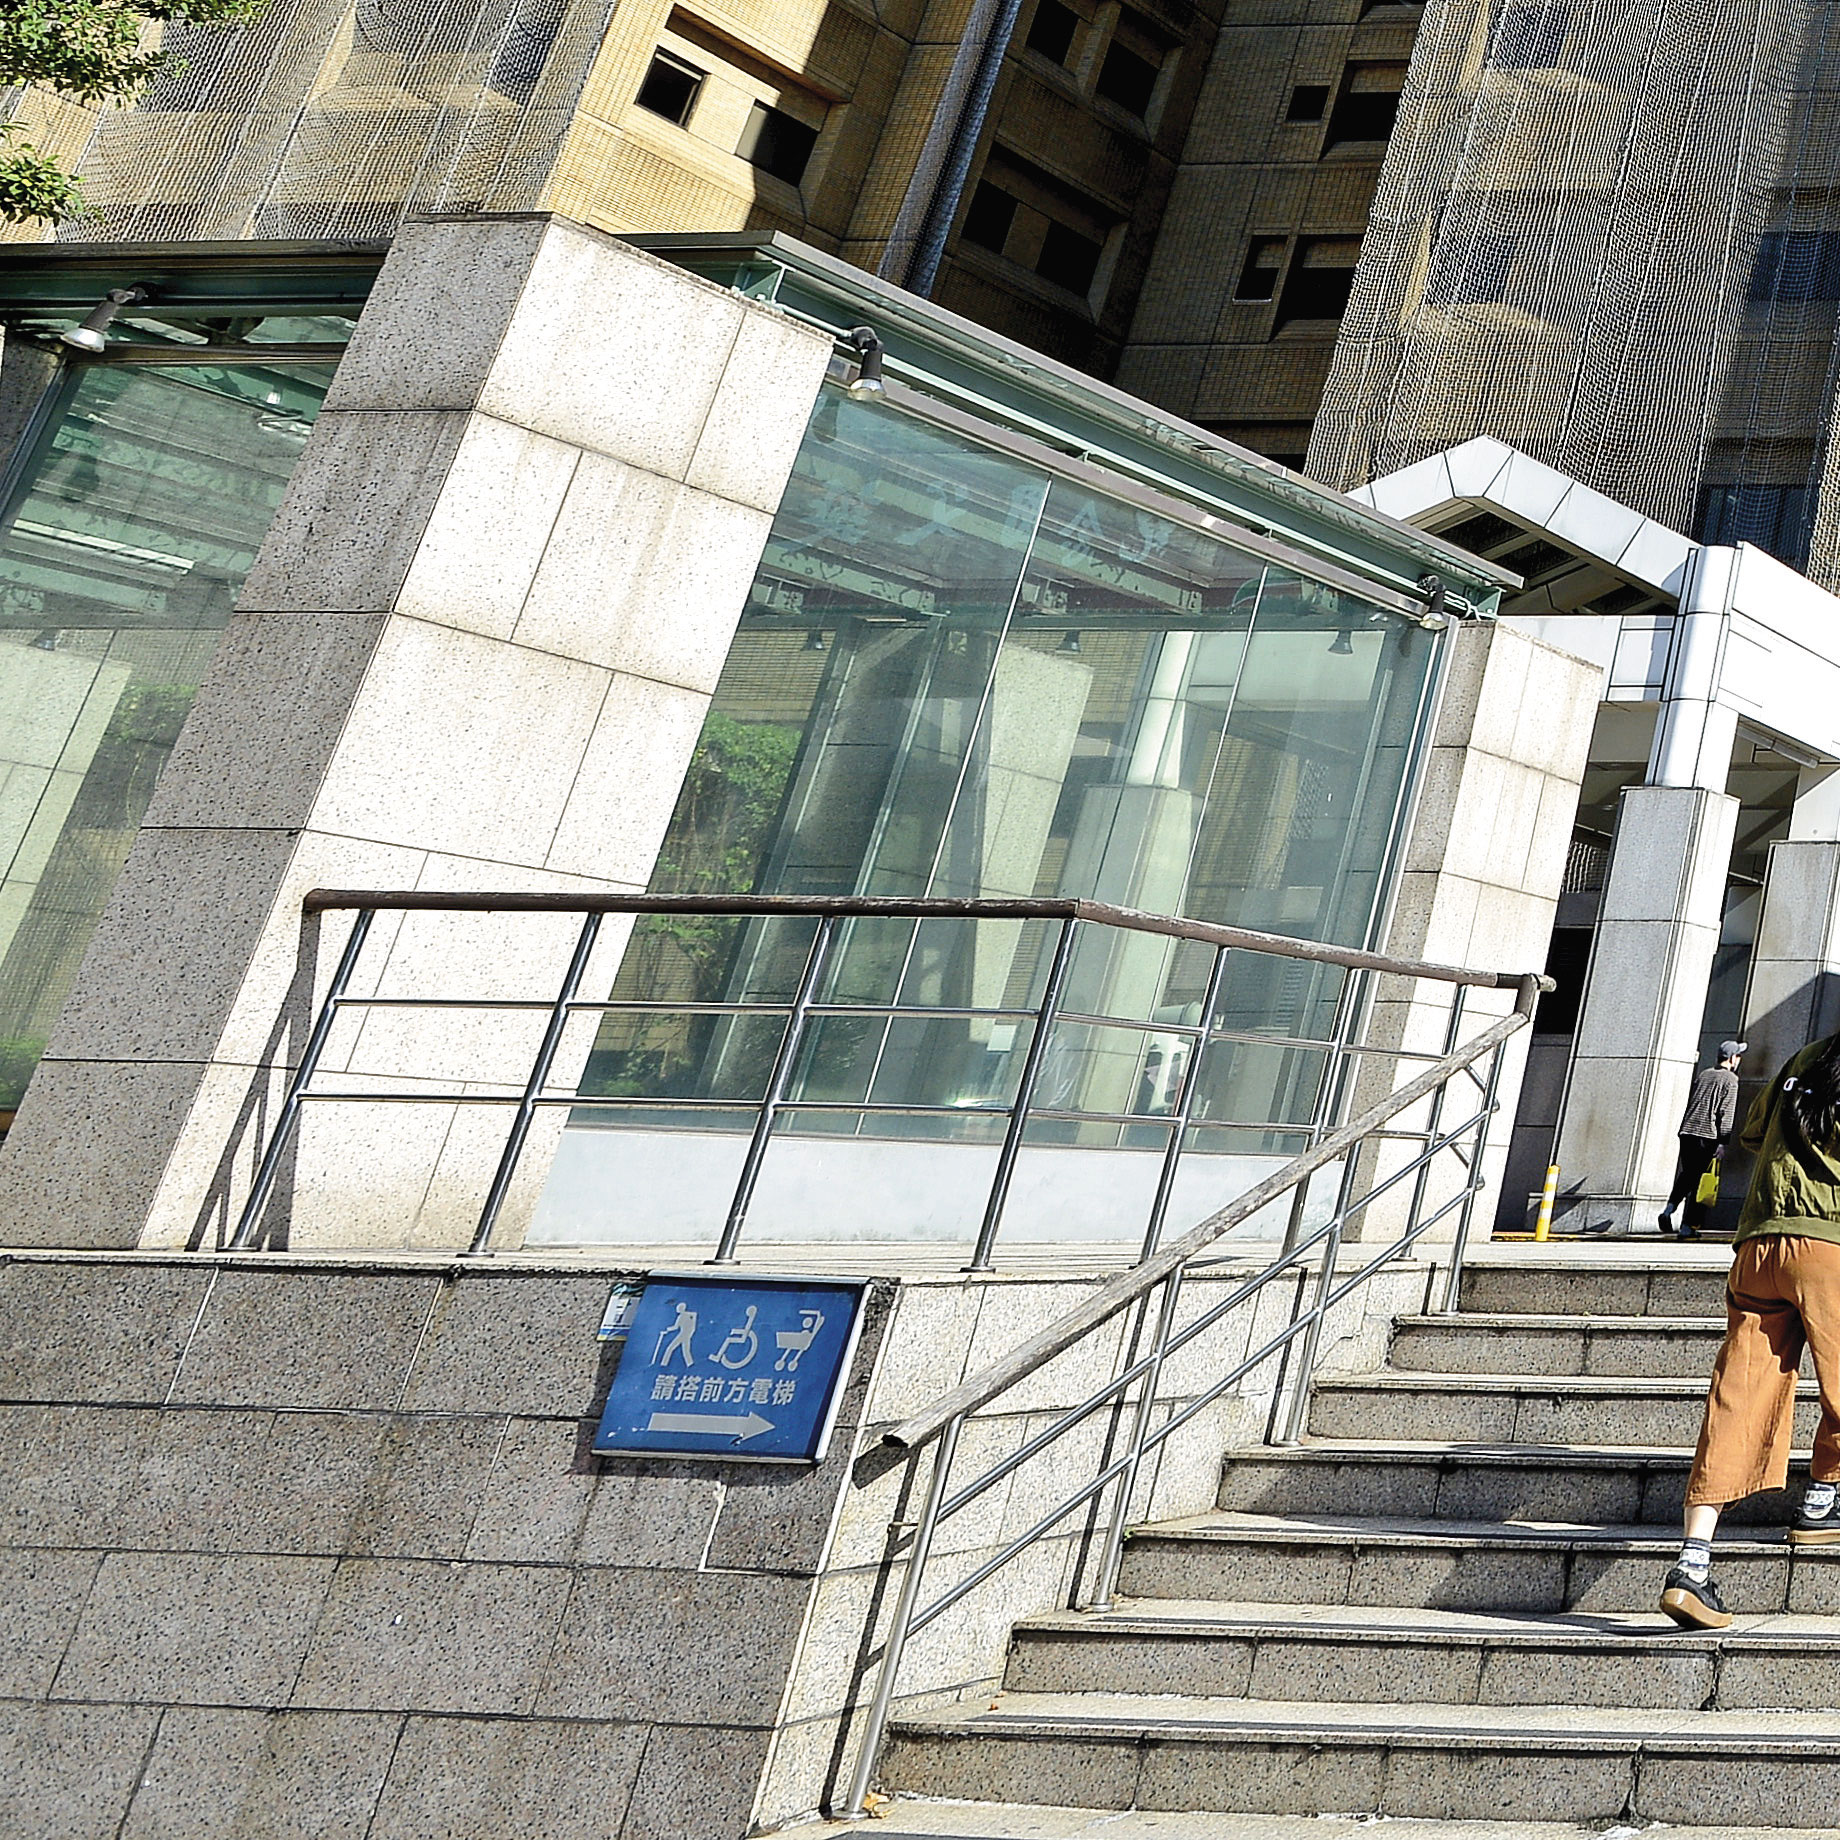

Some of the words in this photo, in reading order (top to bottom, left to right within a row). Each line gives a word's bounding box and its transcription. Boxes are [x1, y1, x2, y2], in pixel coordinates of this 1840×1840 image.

[650, 1374, 797, 1406] 請搭前方電梯
